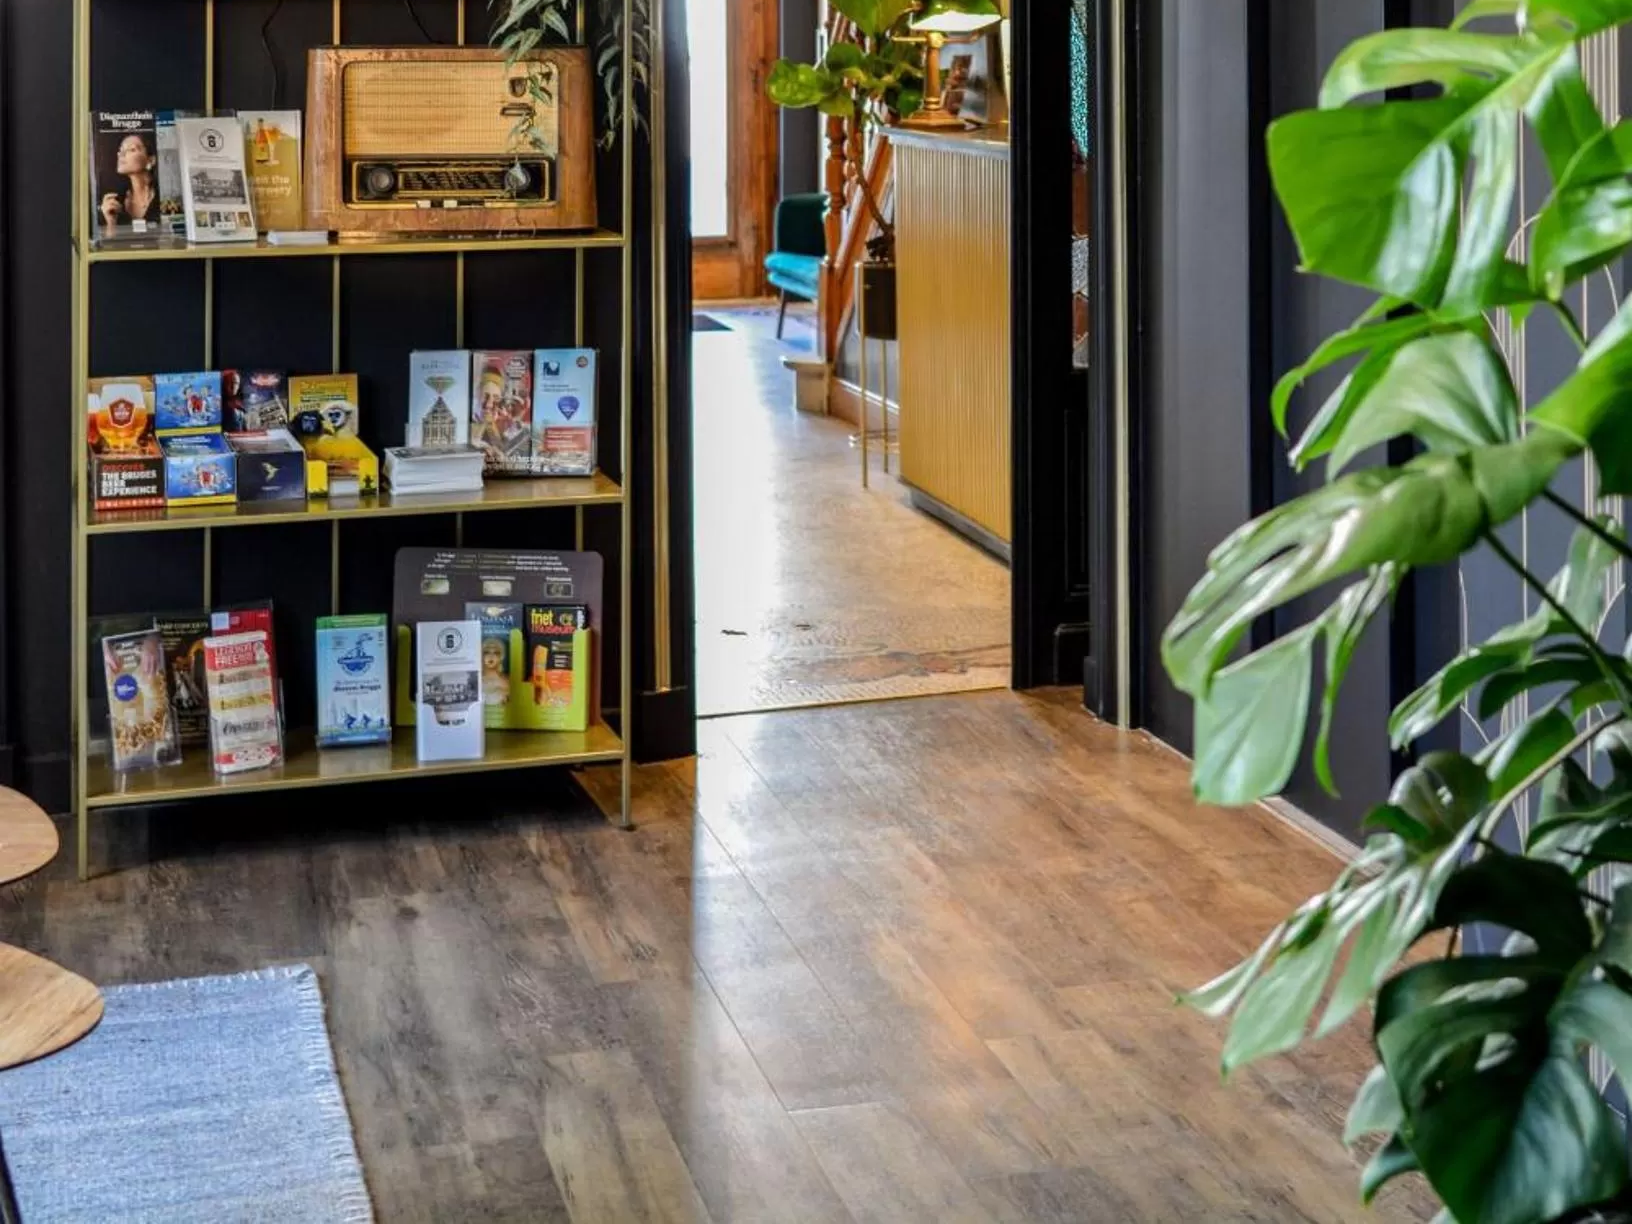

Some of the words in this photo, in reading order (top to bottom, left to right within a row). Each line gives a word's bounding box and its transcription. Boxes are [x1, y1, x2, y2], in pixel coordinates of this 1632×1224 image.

[102, 472, 120, 480] THE
[102, 485, 157, 496] EXPERIENCE
[531, 608, 554, 626] friet
